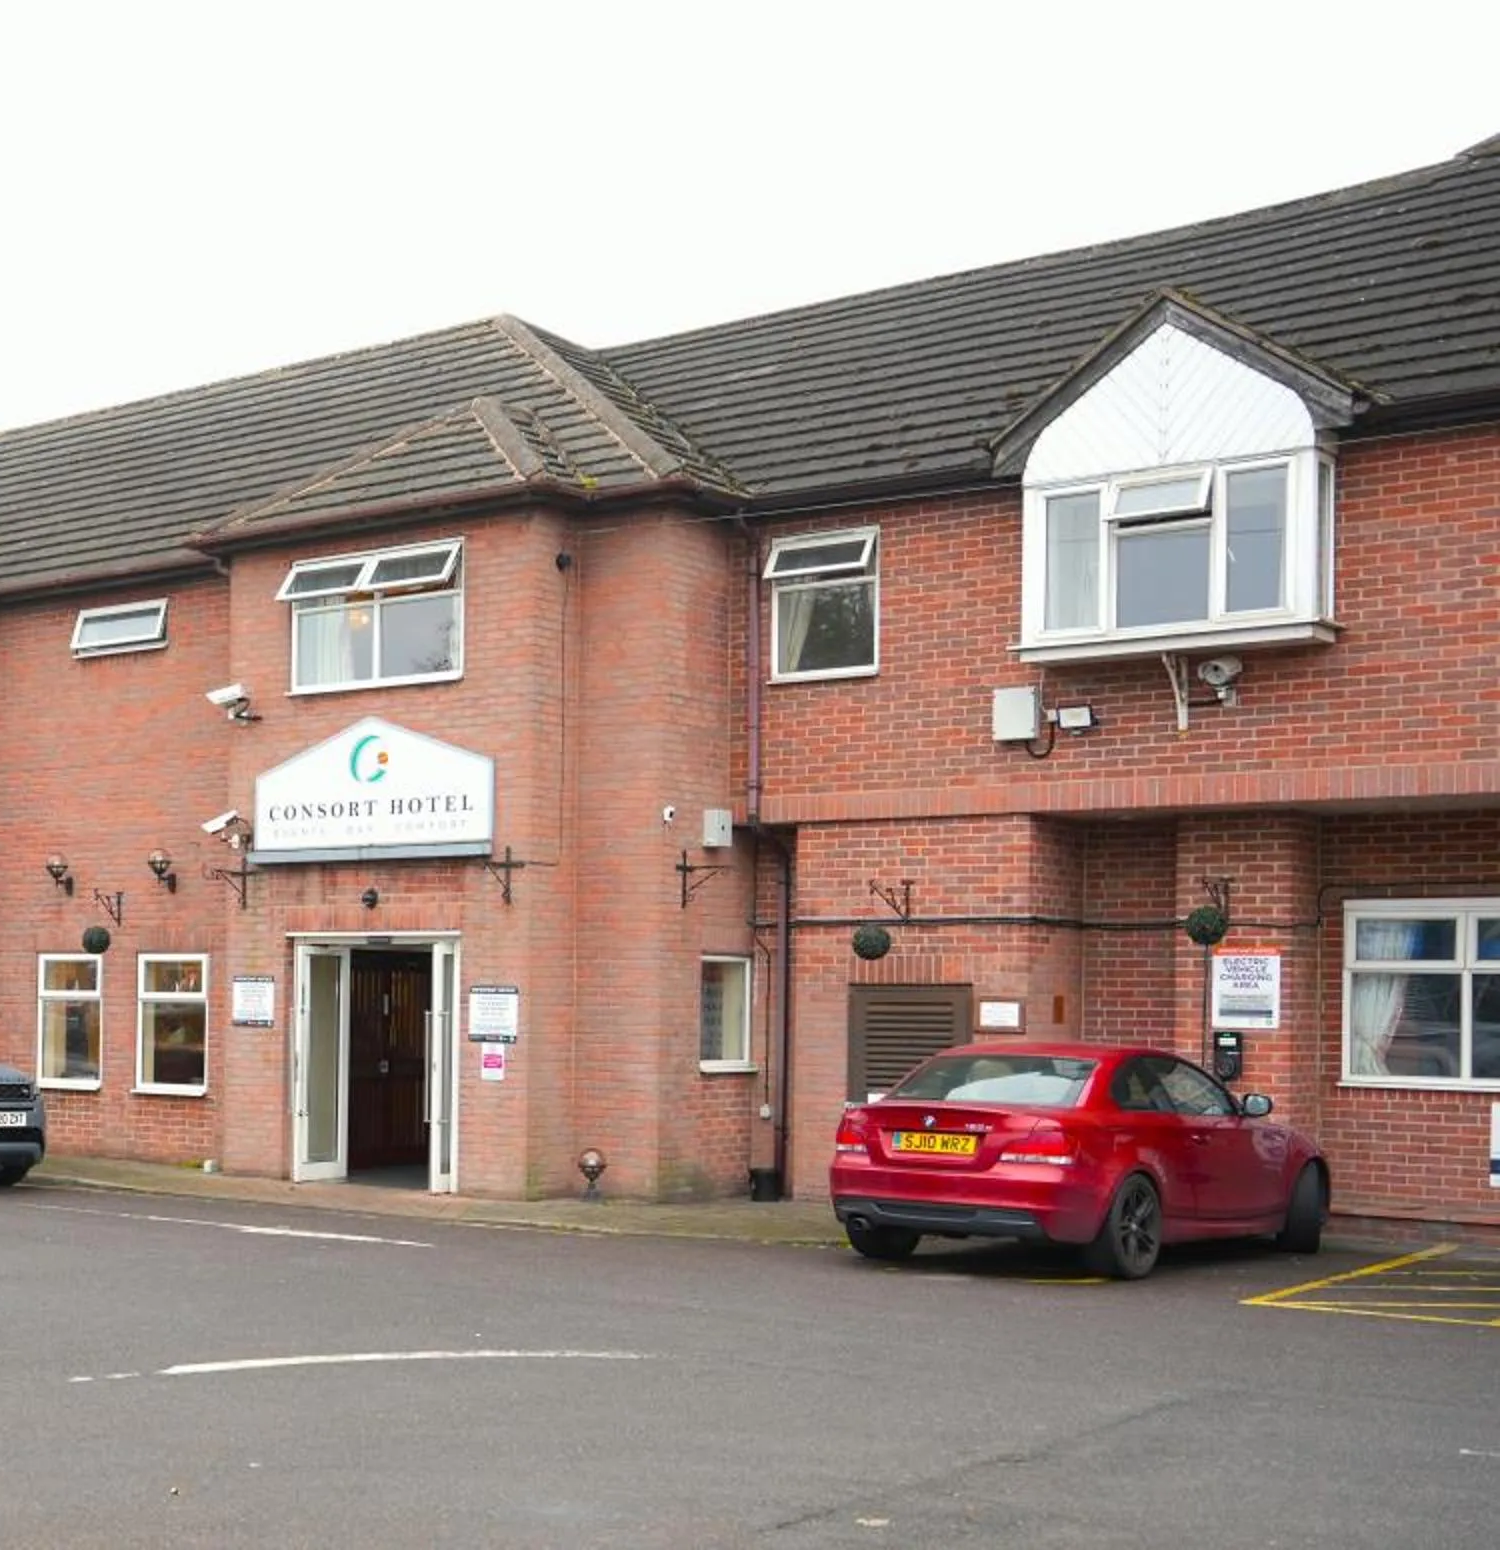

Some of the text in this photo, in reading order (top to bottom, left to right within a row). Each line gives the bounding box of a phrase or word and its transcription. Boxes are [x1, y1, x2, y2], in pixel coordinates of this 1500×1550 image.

[269, 794, 474, 822] CONSORT HOTEL
[1222, 957, 1269, 965] ELECTRIC
[904, 1132, 970, 1152] SJ10 WRZ
